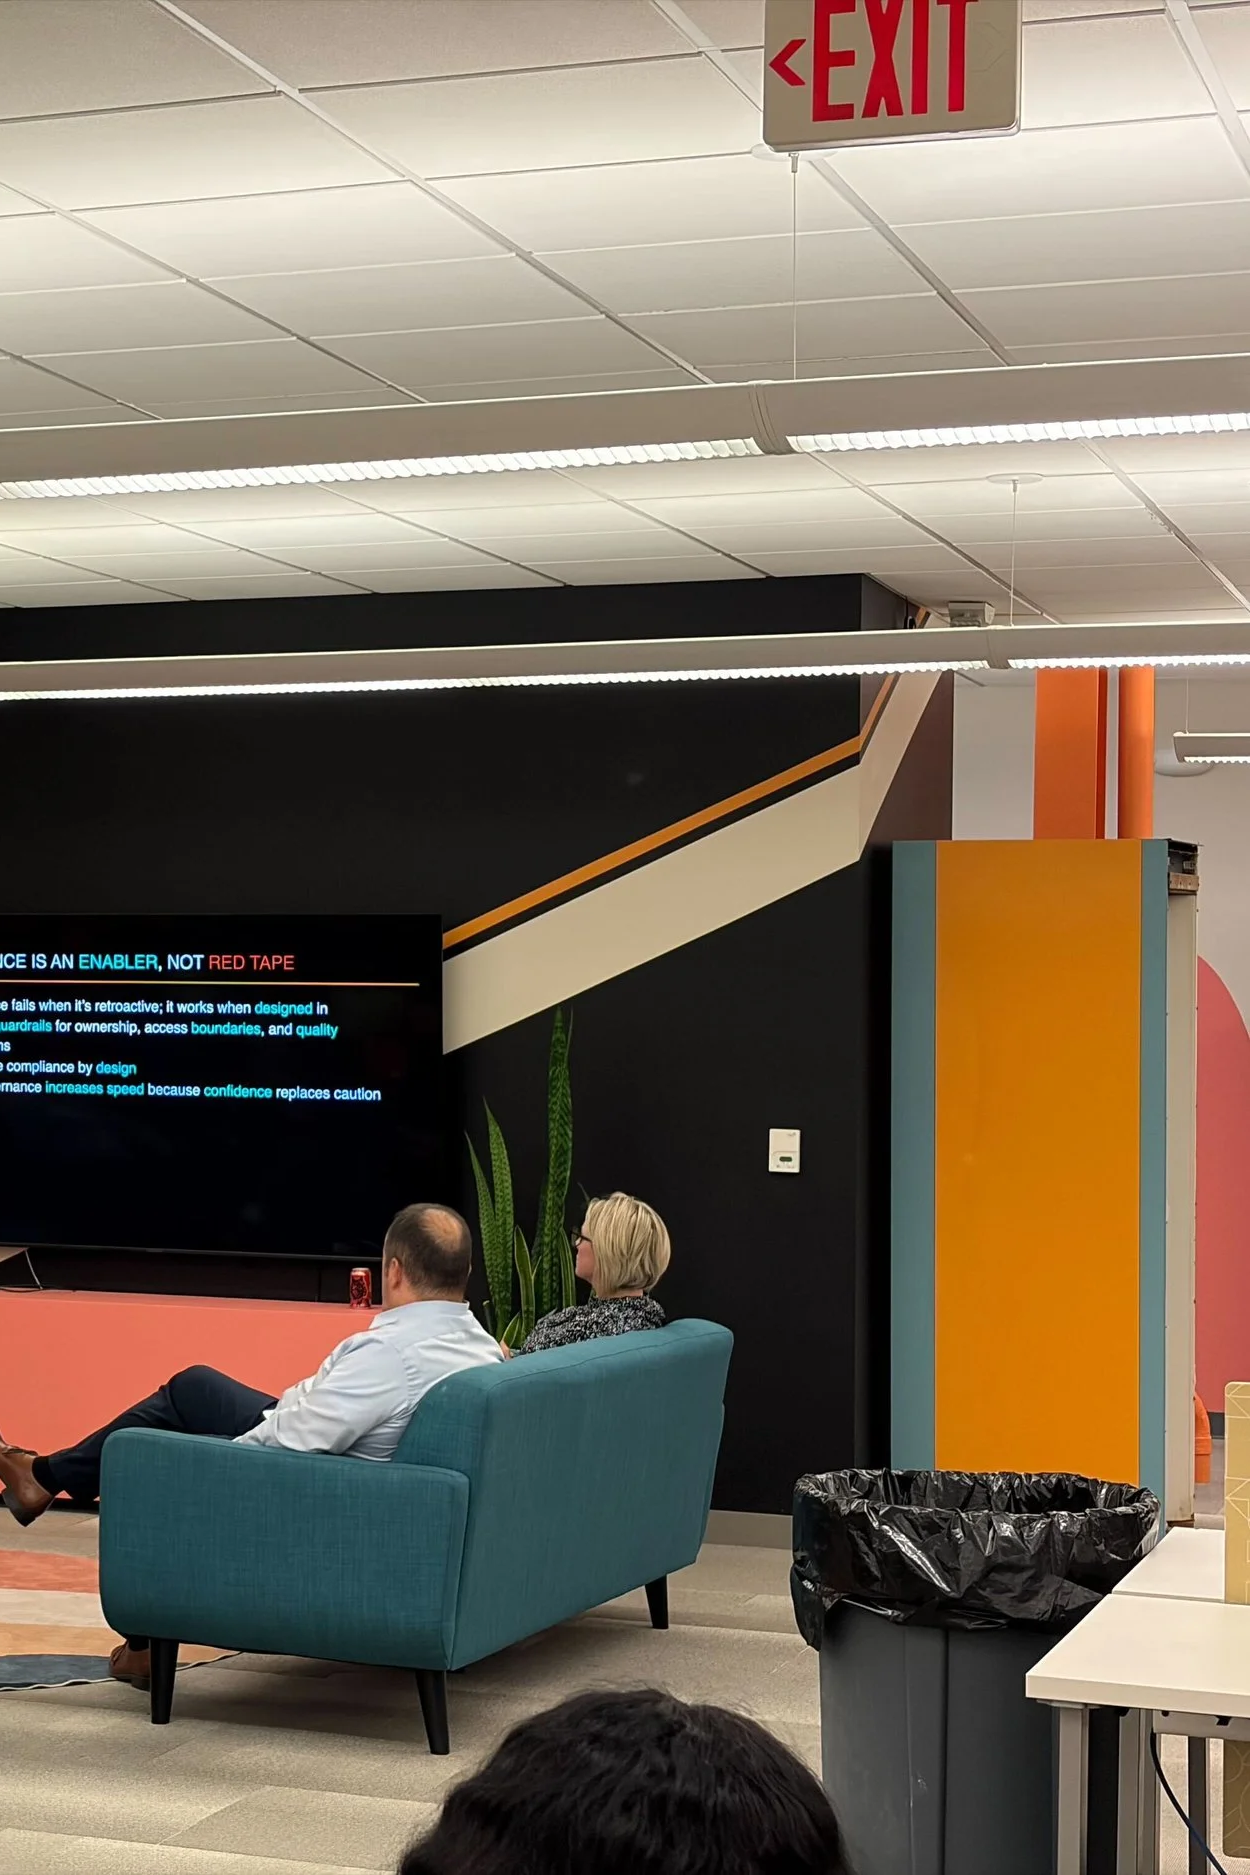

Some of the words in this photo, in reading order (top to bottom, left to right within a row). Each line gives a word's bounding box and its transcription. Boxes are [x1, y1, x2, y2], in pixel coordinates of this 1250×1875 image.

[812, 0, 978, 122] EXIT
[32, 954, 47, 969] IS
[50, 954, 73, 968] AN
[79, 954, 162, 971] ENABLER,
[168, 954, 204, 970] NOT
[209, 955, 246, 970] RED
[249, 955, 295, 970] TAPE
[11, 999, 36, 1011] fails
[39, 999, 71, 1011] when
[95, 1000, 163, 1014] retroactive;
[166, 1000, 174, 1013] it
[177, 1001, 214, 1013] works
[217, 1001, 251, 1014] when
[255, 1002, 313, 1017] designed
[317, 1002, 328, 1014] in
[55, 1019, 72, 1032] for
[74, 1021, 141, 1036] ownership,
[144, 1023, 188, 1034] access
[191, 1022, 264, 1036] boundaries,
[268, 1023, 292, 1035] and
[296, 1023, 338, 1038] quality
[6, 1060, 75, 1075] compliance
[78, 1061, 93, 1076] by
[96, 1062, 136, 1077] design
[46, 1081, 104, 1095] increases
[107, 1083, 144, 1098] speed
[148, 1083, 201, 1096] because
[204, 1085, 272, 1098] confidence
[276, 1086, 330, 1101] replaces
[334, 1088, 381, 1100] caution
